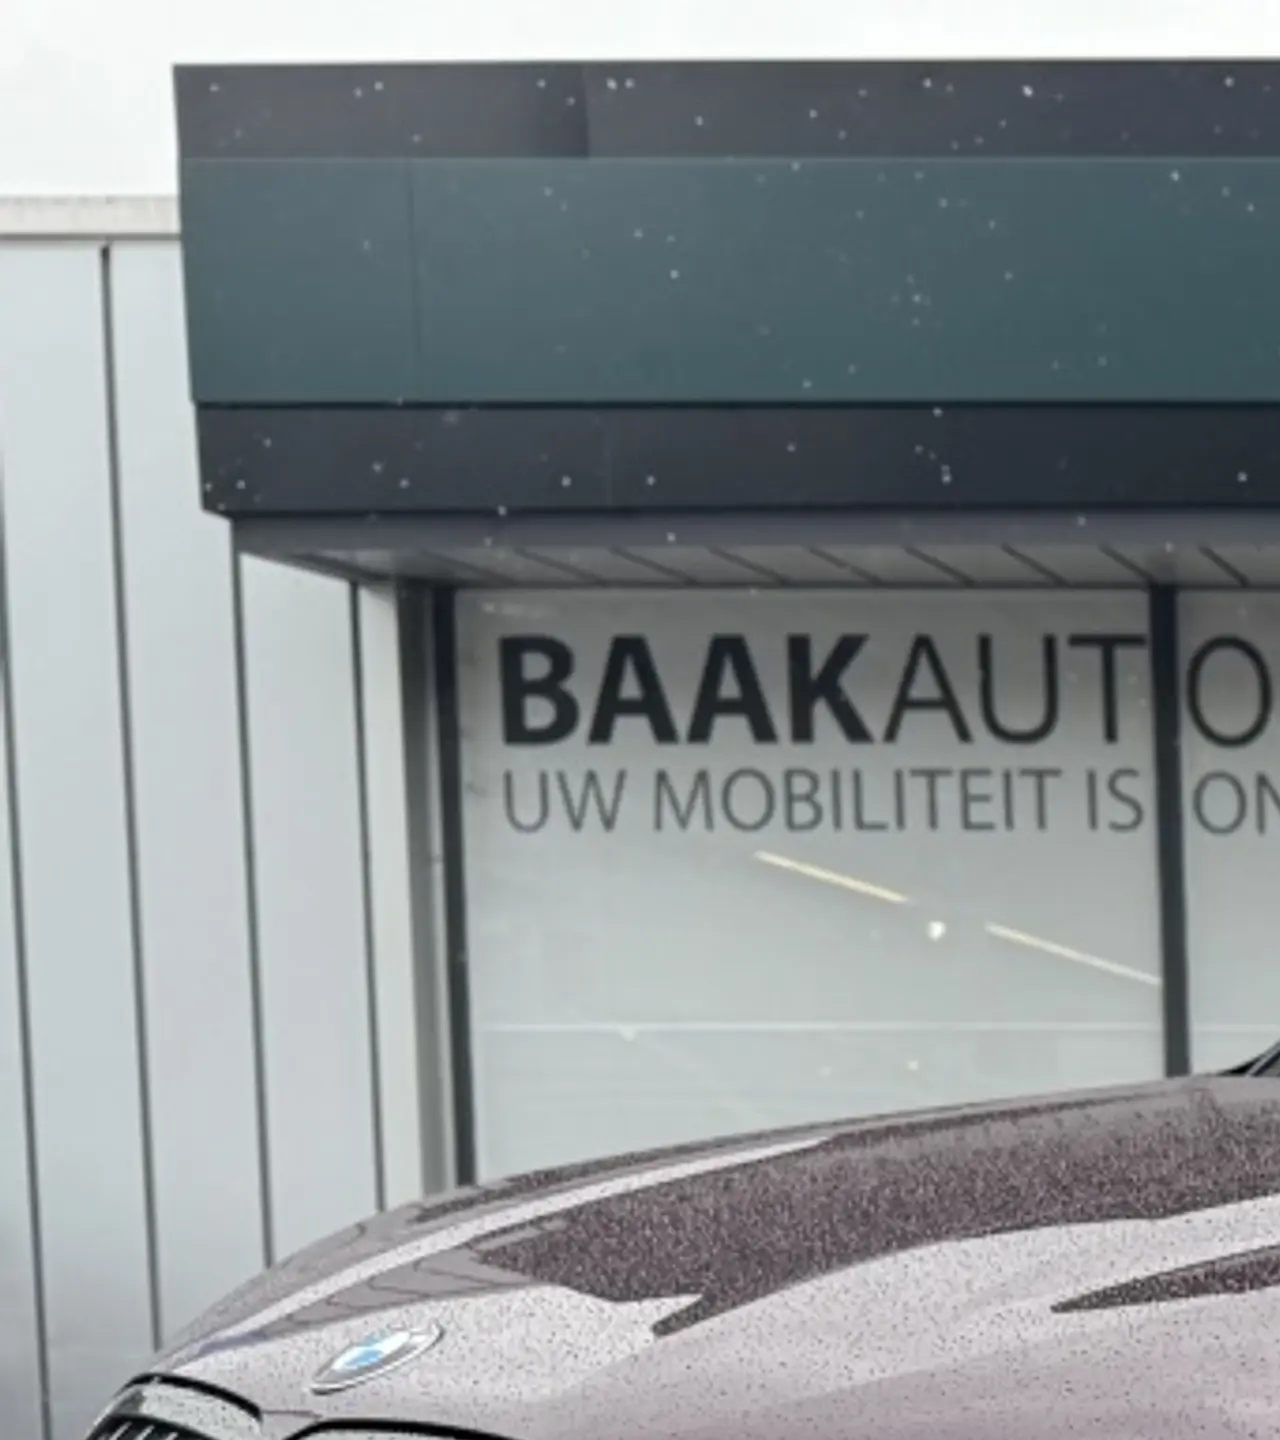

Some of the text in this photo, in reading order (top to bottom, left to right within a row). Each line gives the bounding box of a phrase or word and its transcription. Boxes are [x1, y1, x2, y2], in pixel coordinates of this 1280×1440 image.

[503, 769, 627, 832] UW
[653, 769, 1063, 832] MOBILITEIT
[1085, 769, 1144, 832] IS
